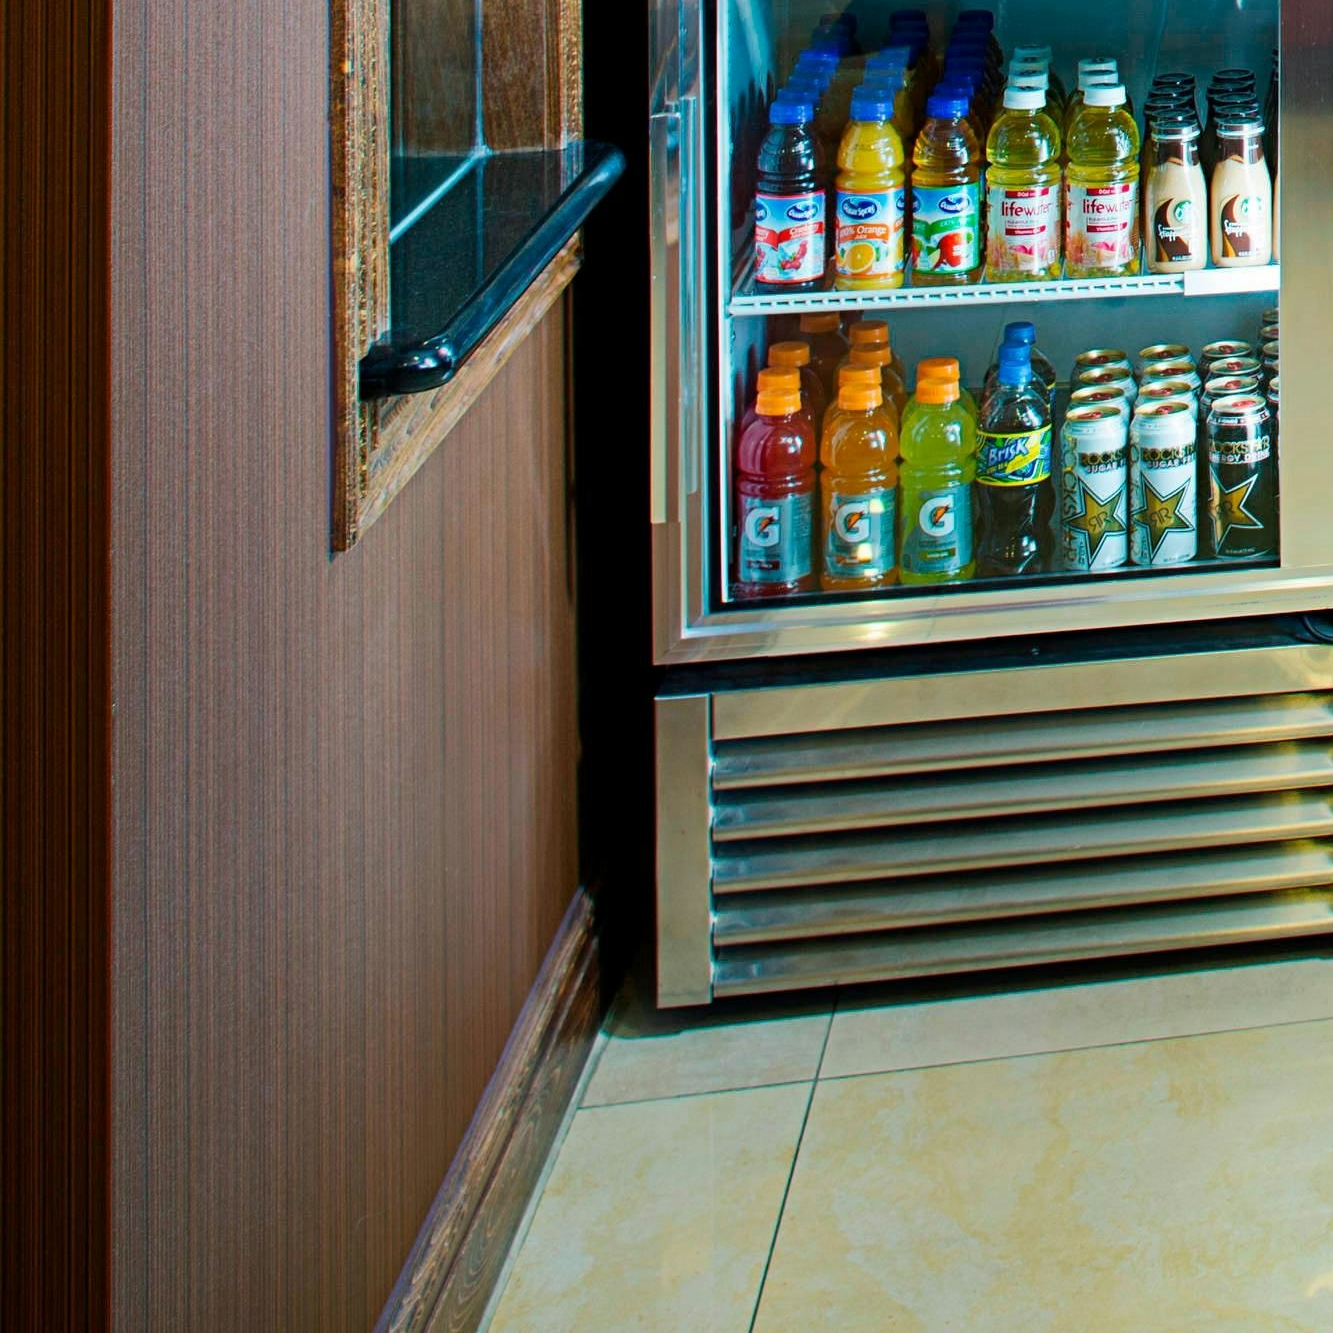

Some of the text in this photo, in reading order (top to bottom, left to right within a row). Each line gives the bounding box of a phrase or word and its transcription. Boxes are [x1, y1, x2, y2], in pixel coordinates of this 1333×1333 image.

[857, 225, 887, 236] Orange
[987, 437, 1029, 464] Brisk
[1147, 458, 1180, 470] SUGAR
[744, 507, 780, 547] G
[835, 501, 870, 543] G
[918, 494, 955, 537] G
